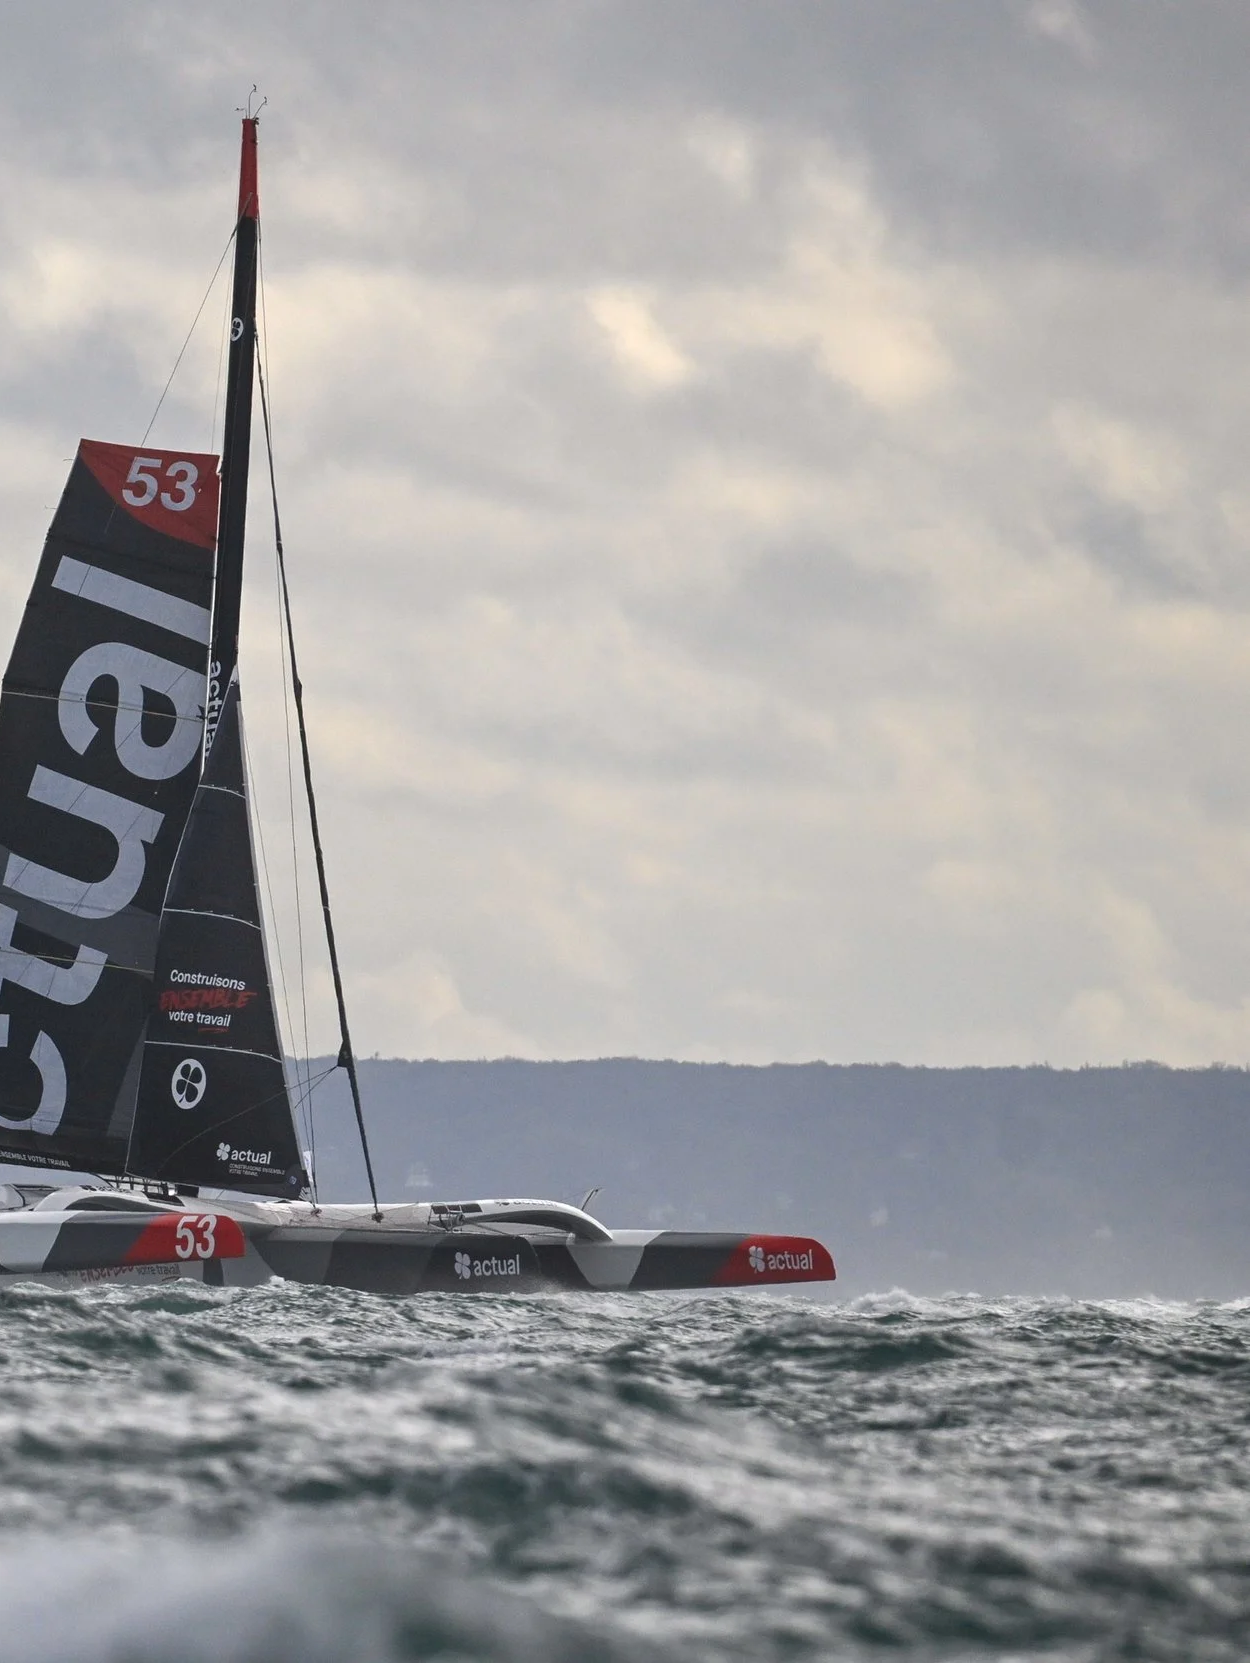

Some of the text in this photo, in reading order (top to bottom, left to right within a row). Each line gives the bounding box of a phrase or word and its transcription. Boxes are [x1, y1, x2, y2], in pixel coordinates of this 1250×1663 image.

[121, 456, 199, 511] 53
[205, 660, 223, 757] actua
[170, 969, 247, 991] Construisons
[168, 1009, 232, 1027] votre travail
[27, 1154, 48, 1164] VOTRE
[48, 1158, 71, 1168] TRAVAIL
[230, 1149, 272, 1165] actual
[175, 1214, 218, 1259] 53
[473, 1254, 520, 1276] actual
[767, 1249, 813, 1270] actual
